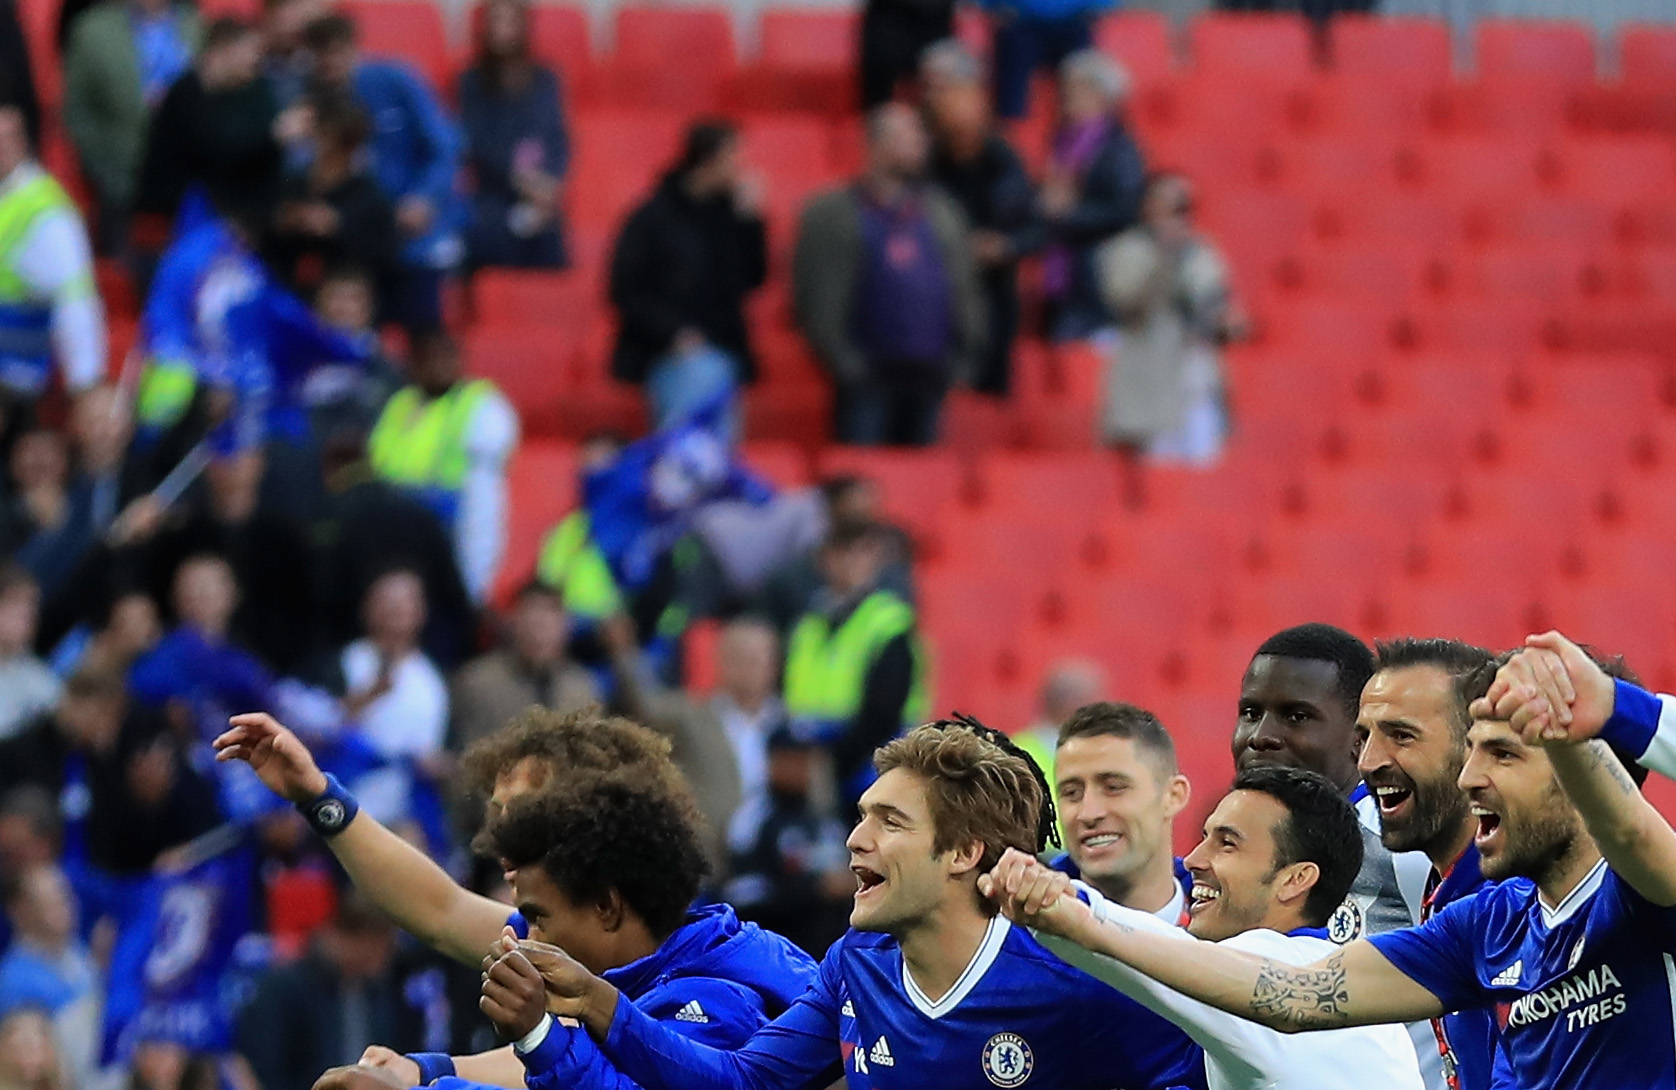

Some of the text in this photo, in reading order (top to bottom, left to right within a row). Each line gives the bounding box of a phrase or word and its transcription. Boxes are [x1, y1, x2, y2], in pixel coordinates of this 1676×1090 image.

[675, 1011, 709, 1024] adidas
[1566, 994, 1627, 1033] TYRES
[870, 1052, 895, 1067] adidas
